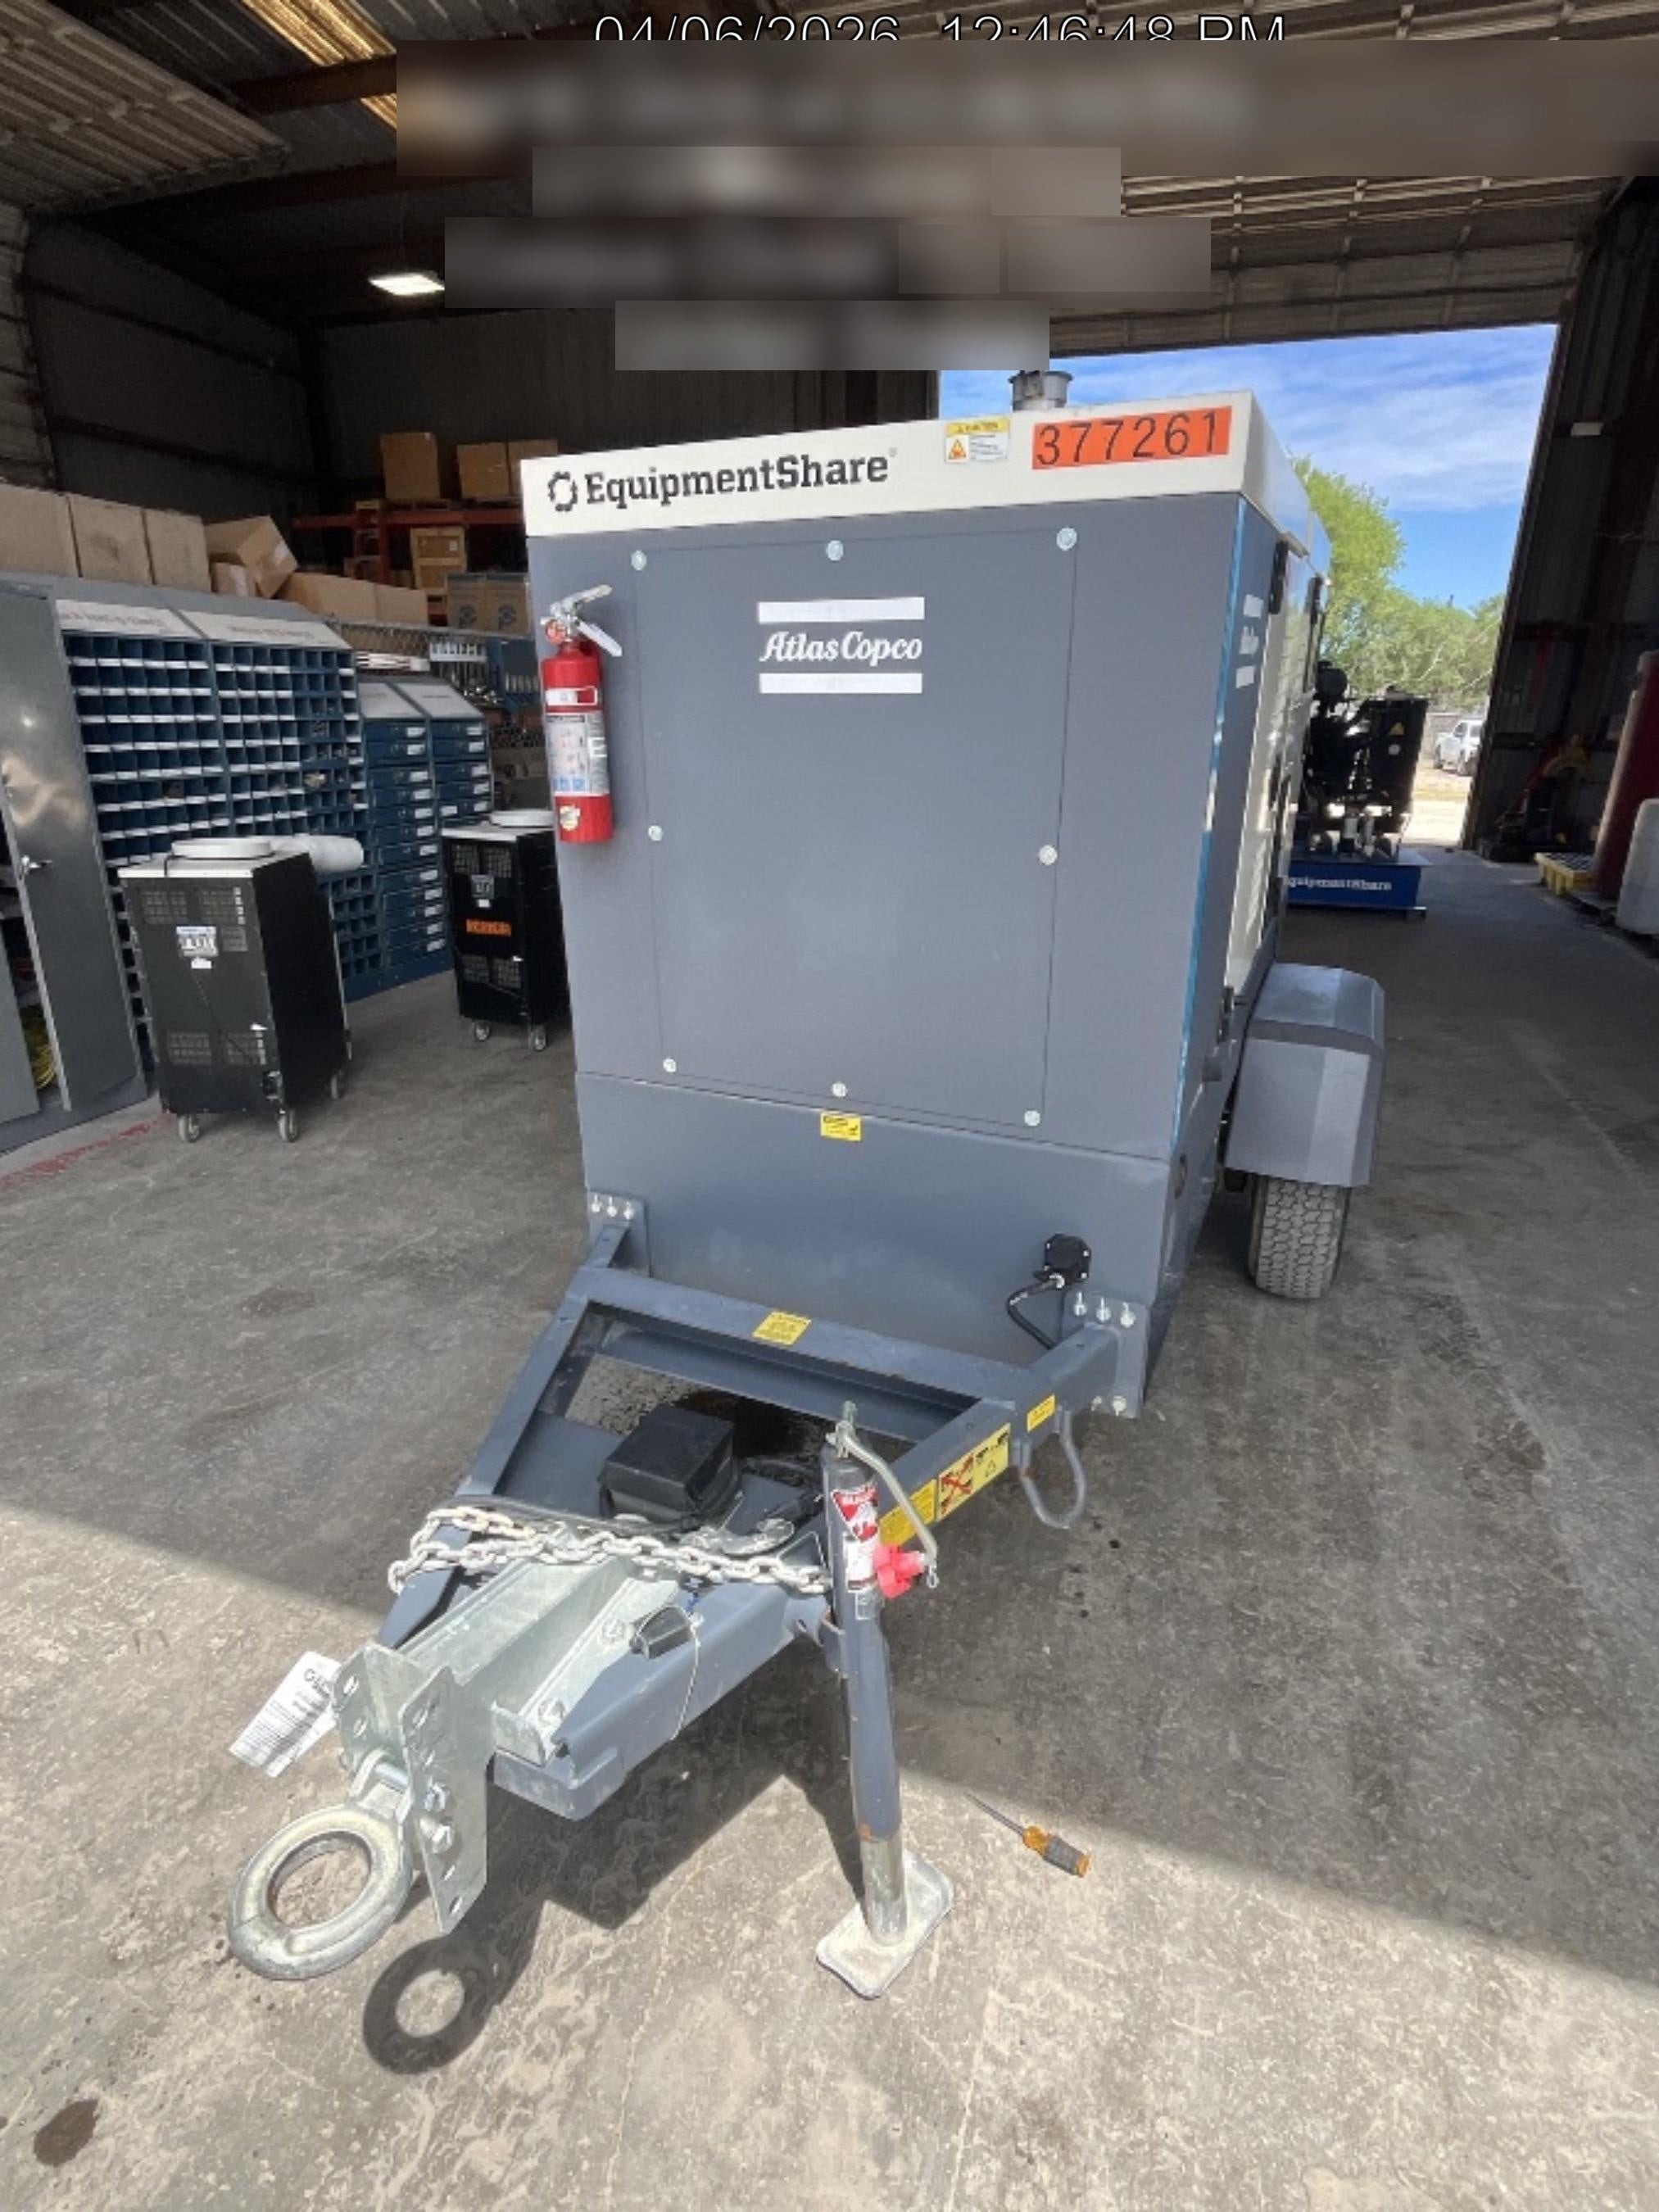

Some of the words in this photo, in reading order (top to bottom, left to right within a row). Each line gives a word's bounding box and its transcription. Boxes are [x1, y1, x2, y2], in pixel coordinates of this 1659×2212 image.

[1036, 411, 1217, 466] 377261
[584, 454, 889, 510] EquipmentShare
[759, 631, 840, 663] Atlas
[841, 631, 923, 668] Copco
[1288, 877, 1392, 891] quipmentShare
